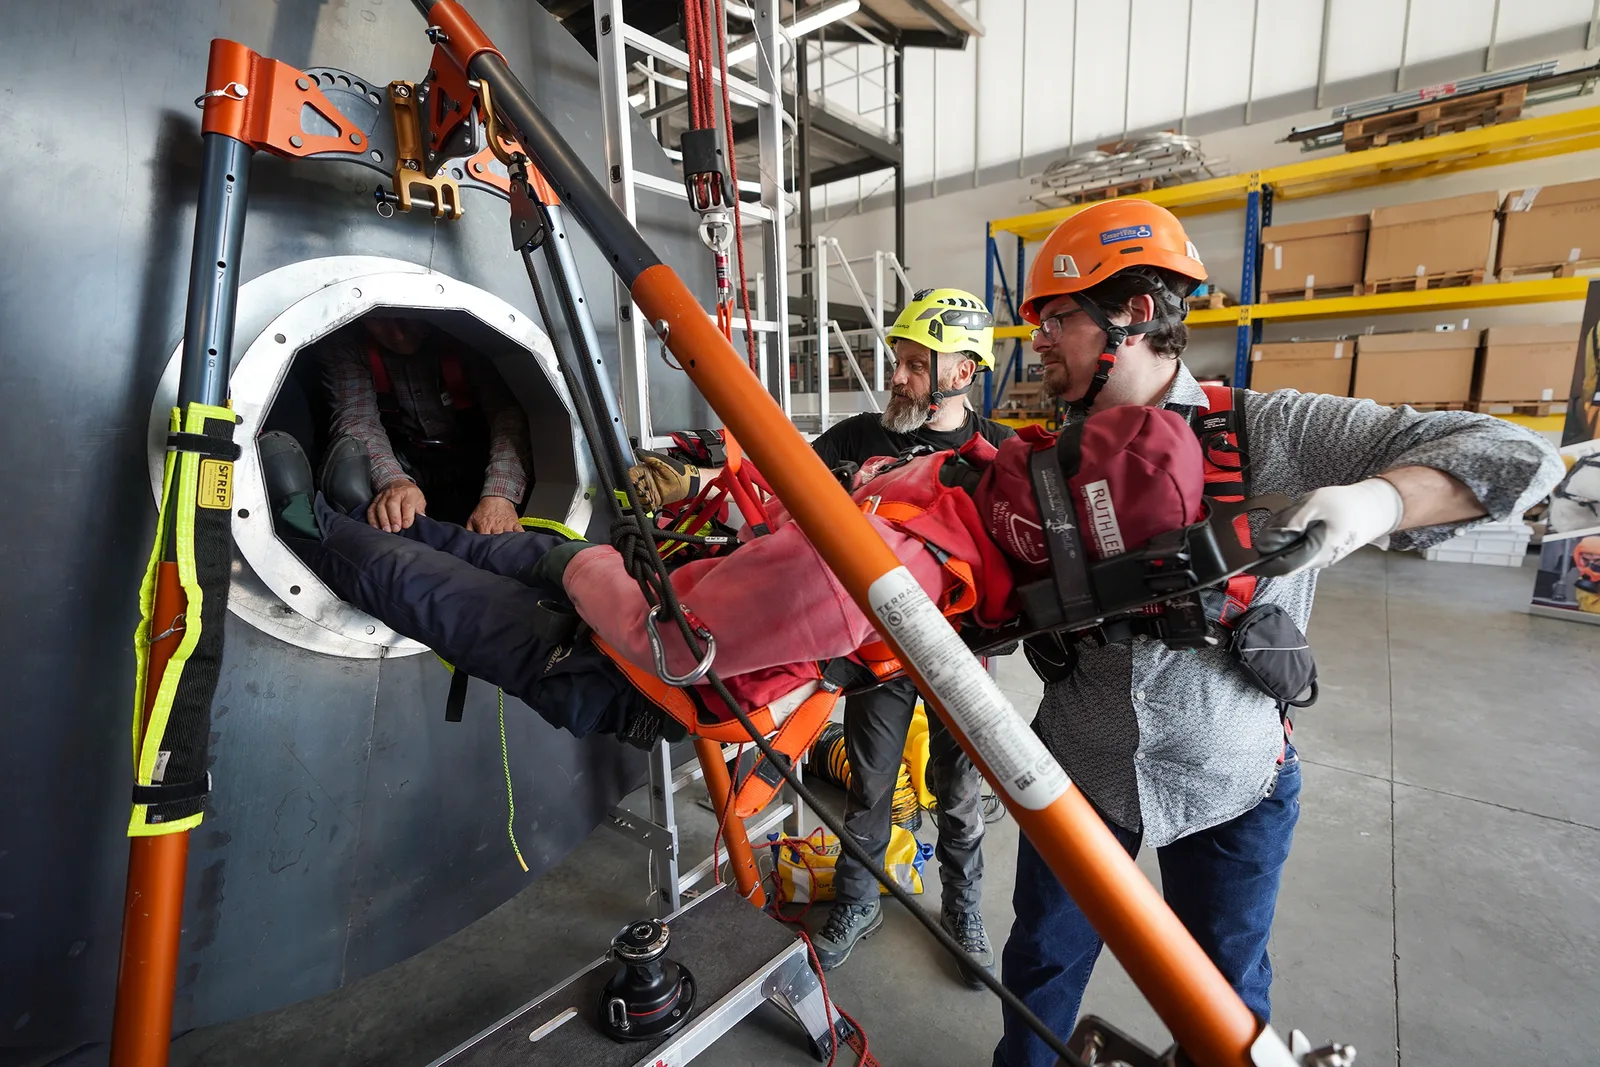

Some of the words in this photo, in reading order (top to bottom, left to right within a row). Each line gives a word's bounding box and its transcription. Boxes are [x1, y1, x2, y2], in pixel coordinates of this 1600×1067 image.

[225, 184, 233, 194] 8
[207, 359, 216, 368] 6
[1092, 488, 1110, 532] RUTH
[1102, 533, 1121, 559] LEE
